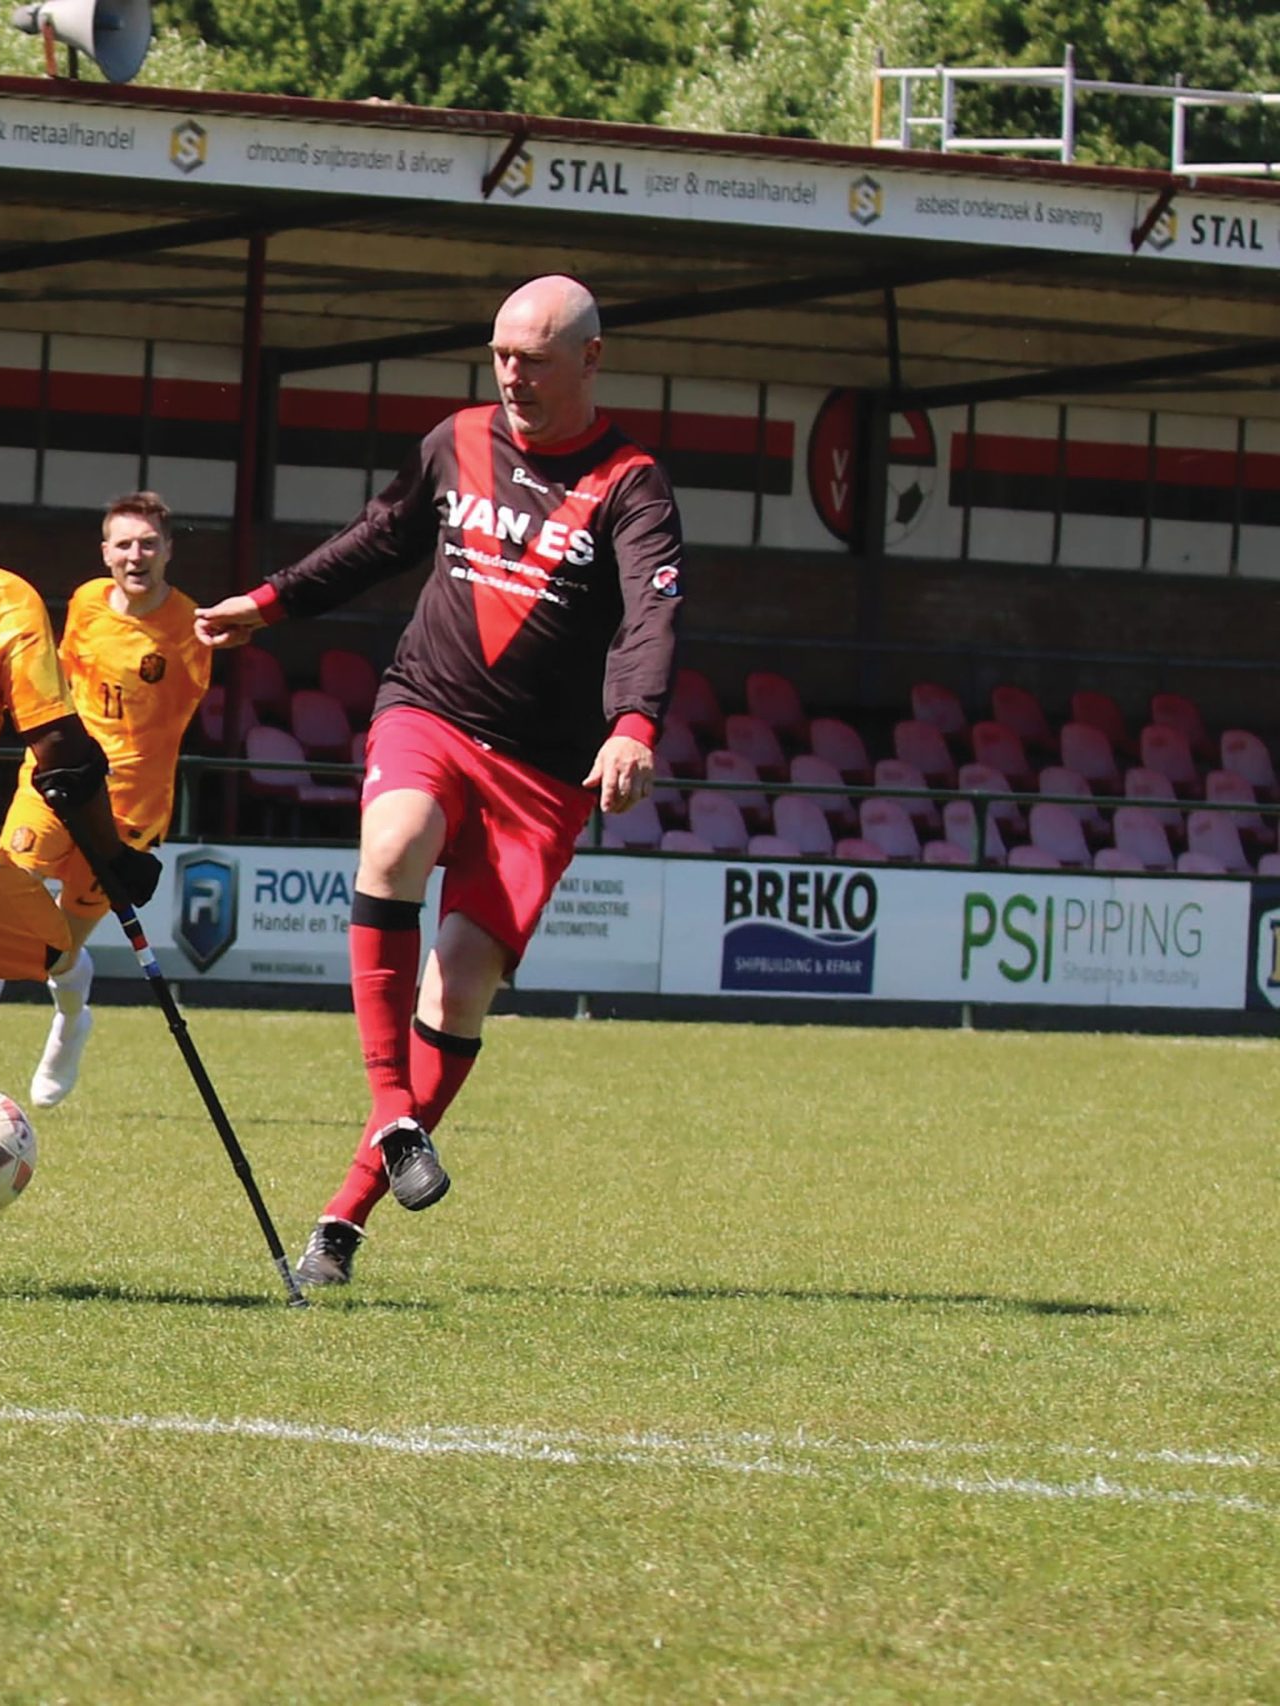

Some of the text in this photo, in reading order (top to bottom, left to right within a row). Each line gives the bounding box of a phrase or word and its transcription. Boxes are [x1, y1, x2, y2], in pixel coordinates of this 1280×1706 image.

[12, 121, 135, 150] metaalhandel
[312, 144, 393, 172] snijbranden
[396, 149, 407, 171] &
[409, 149, 454, 175] afvoer
[548, 157, 817, 205] STAL ijzer & metaalhandel
[915, 195, 1104, 235] asbest onderzoek & sanering
[1190, 213, 1264, 251] STAL
[445, 489, 596, 566] VAN ES
[100, 681, 124, 720] 11
[254, 869, 357, 905] ROVA
[723, 866, 879, 932] BREKO
[252, 911, 305, 933] Handel
[308, 915, 327, 933] en
[960, 891, 1054, 984] PSI
[1063, 898, 1204, 958] PIPING
[735, 955, 812, 975] SHIPBUILDING
[826, 958, 864, 975] REPAIR
[1062, 961, 1125, 988] Shipping
[1141, 967, 1200, 989] Industry
